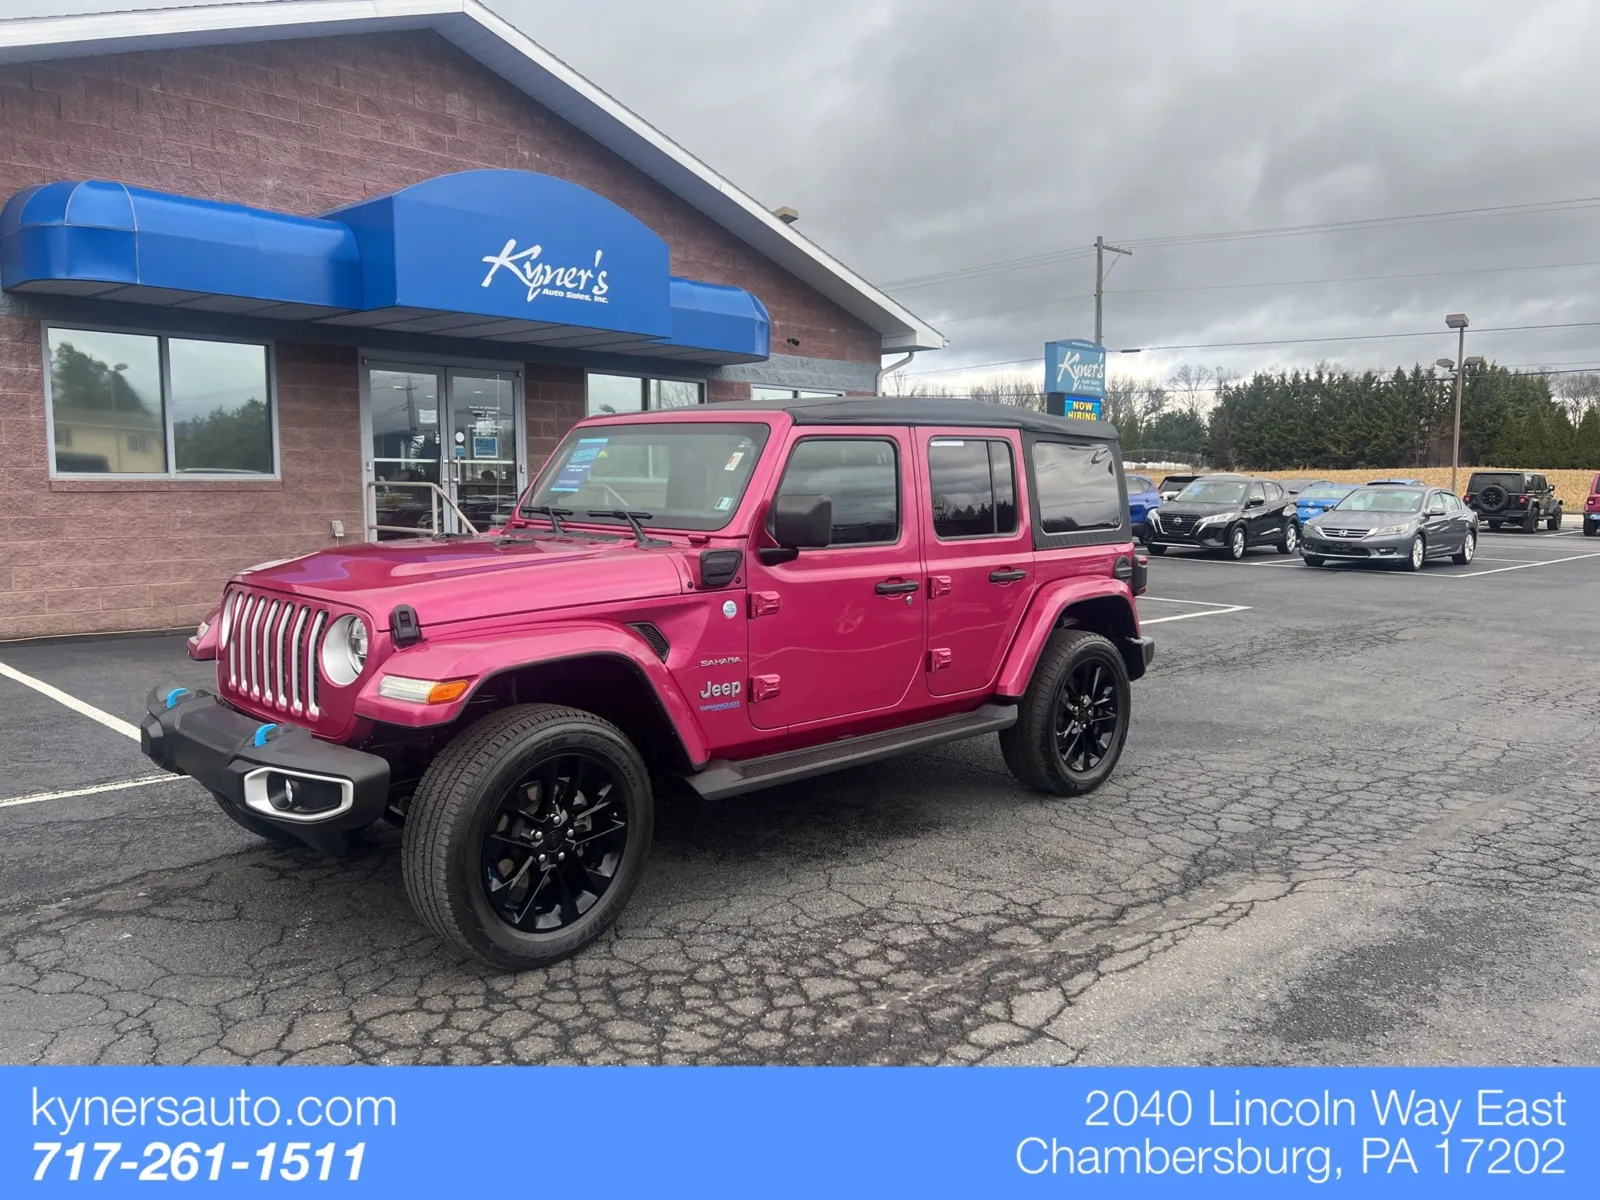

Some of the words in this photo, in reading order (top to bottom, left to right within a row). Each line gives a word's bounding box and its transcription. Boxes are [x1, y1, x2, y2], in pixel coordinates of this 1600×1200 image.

[481, 238, 608, 303] Kyner's
[542, 288, 564, 297] Auto
[565, 291, 592, 302] Sales,
[593, 295, 609, 304] Inc.
[1057, 351, 1103, 391] Kyner's
[1073, 401, 1093, 410] NOW
[1068, 411, 1096, 420] HIRING
[700, 656, 742, 667] SAHARA
[700, 680, 742, 699] Jeep
